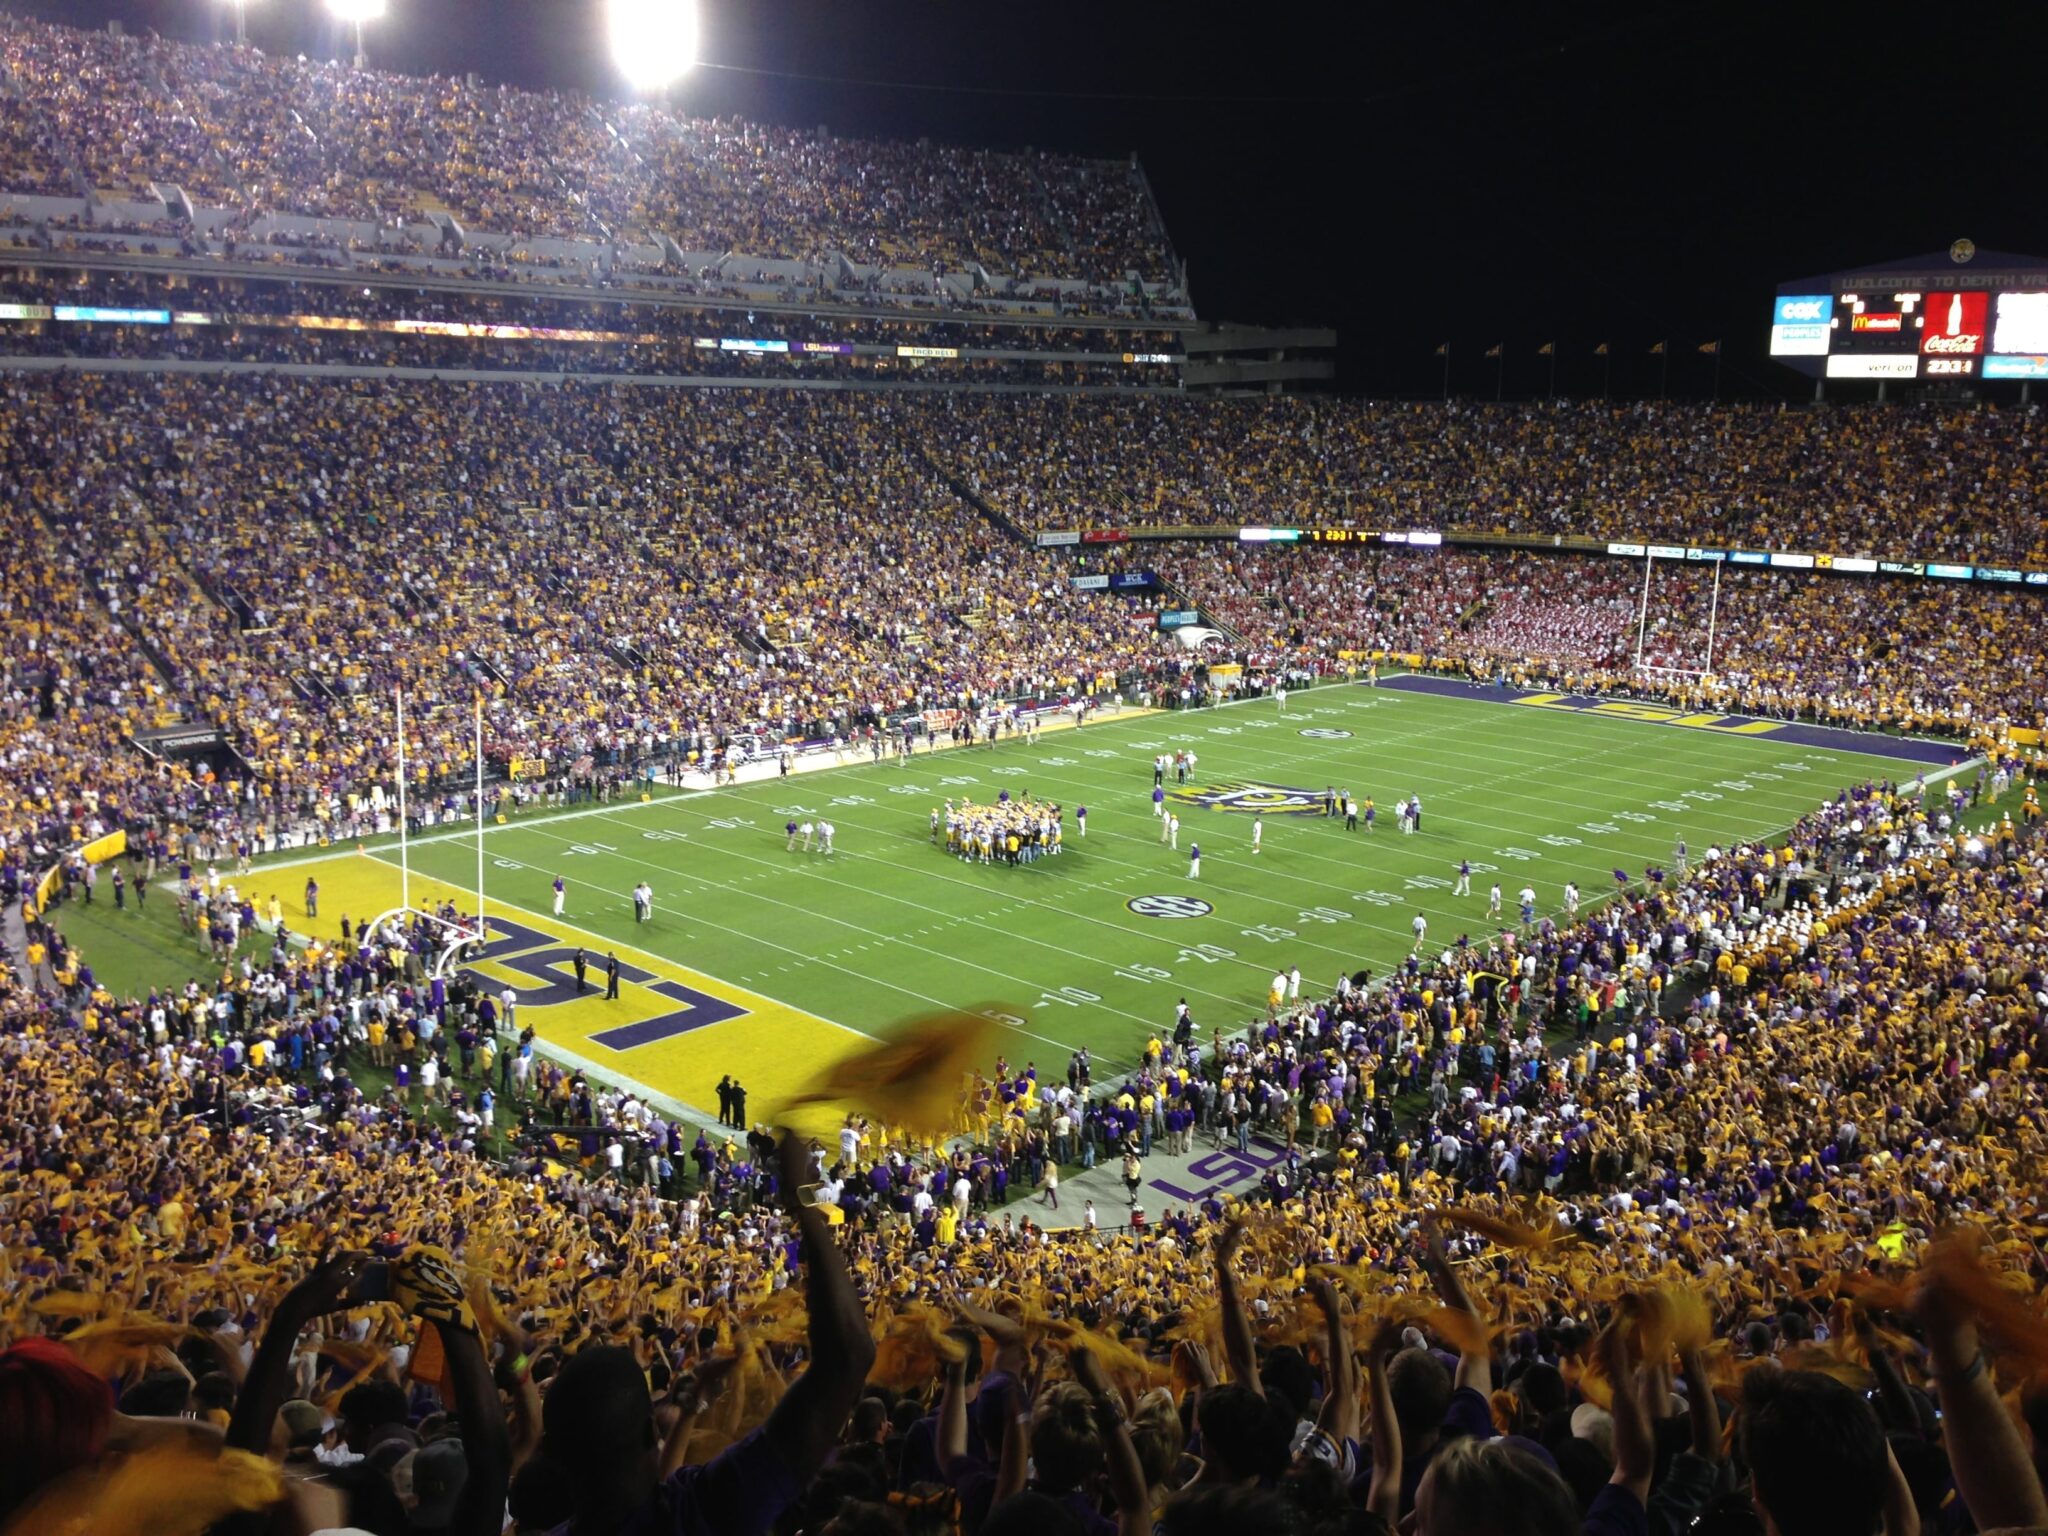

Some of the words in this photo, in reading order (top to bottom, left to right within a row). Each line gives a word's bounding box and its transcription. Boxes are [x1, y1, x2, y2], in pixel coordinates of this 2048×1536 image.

[1842, 278, 1927, 289] WELCOME
[1935, 277, 1955, 287] TO
[1960, 276, 2016, 287] DEATH
[1782, 302, 1824, 320] COX
[1509, 693, 1787, 734] LSU
[710, 817, 755, 828] 20
[643, 830, 688, 841] 15
[570, 843, 617, 854] 10
[1493, 847, 1542, 860] 50
[494, 860, 523, 870] 5
[1404, 875, 1453, 888] 40
[1352, 890, 1404, 906] 35
[1130, 895, 1210, 918] SEC
[1298, 907, 1352, 923] 30
[1240, 924, 1296, 943] 25
[1178, 944, 1236, 963] 20
[1113, 964, 1171, 983] 15
[455, 916, 753, 1052] LSU
[1040, 987, 1101, 1006] 10
[980, 1009, 1025, 1025] 5
[1148, 1136, 1288, 1203] LSU
